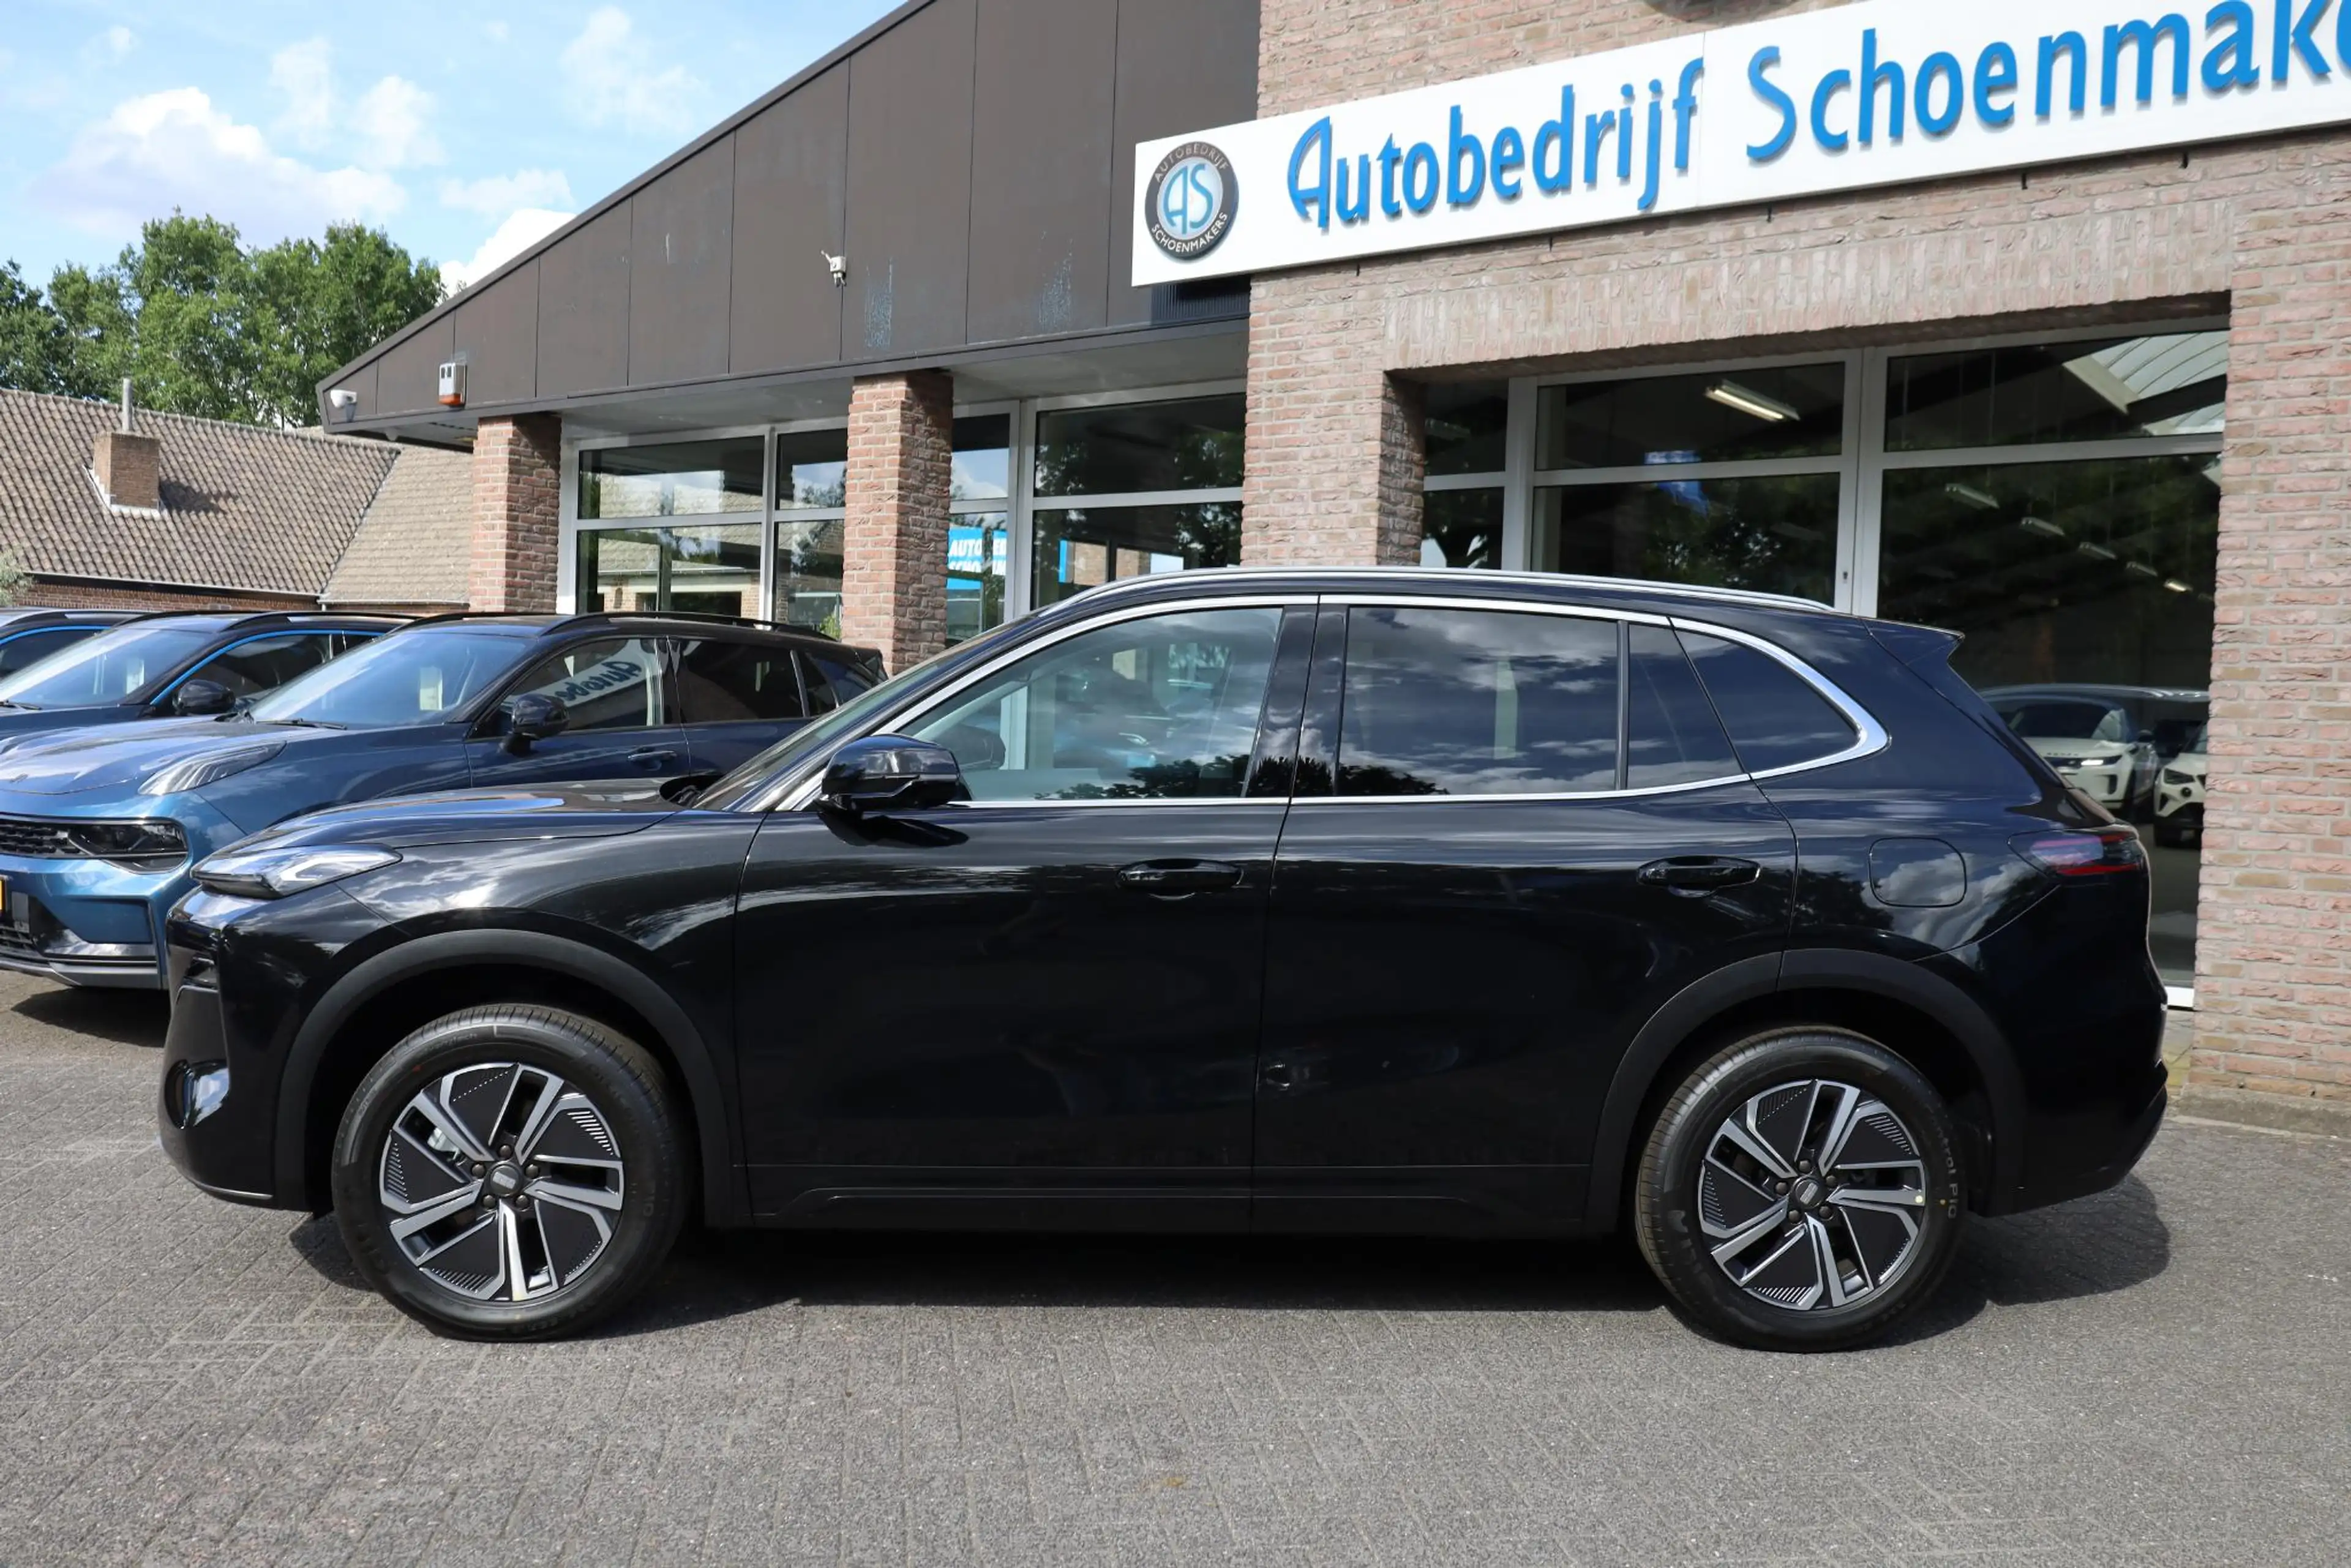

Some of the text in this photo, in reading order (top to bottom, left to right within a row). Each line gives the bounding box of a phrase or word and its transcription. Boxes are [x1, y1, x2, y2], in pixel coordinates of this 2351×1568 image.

[1154, 143, 1229, 182] AUTOBEDRIJF
[1287, 56, 1703, 228] Autobedrijf
[1163, 163, 1214, 235] AS
[1151, 212, 1228, 253] SCHOENMAKERS
